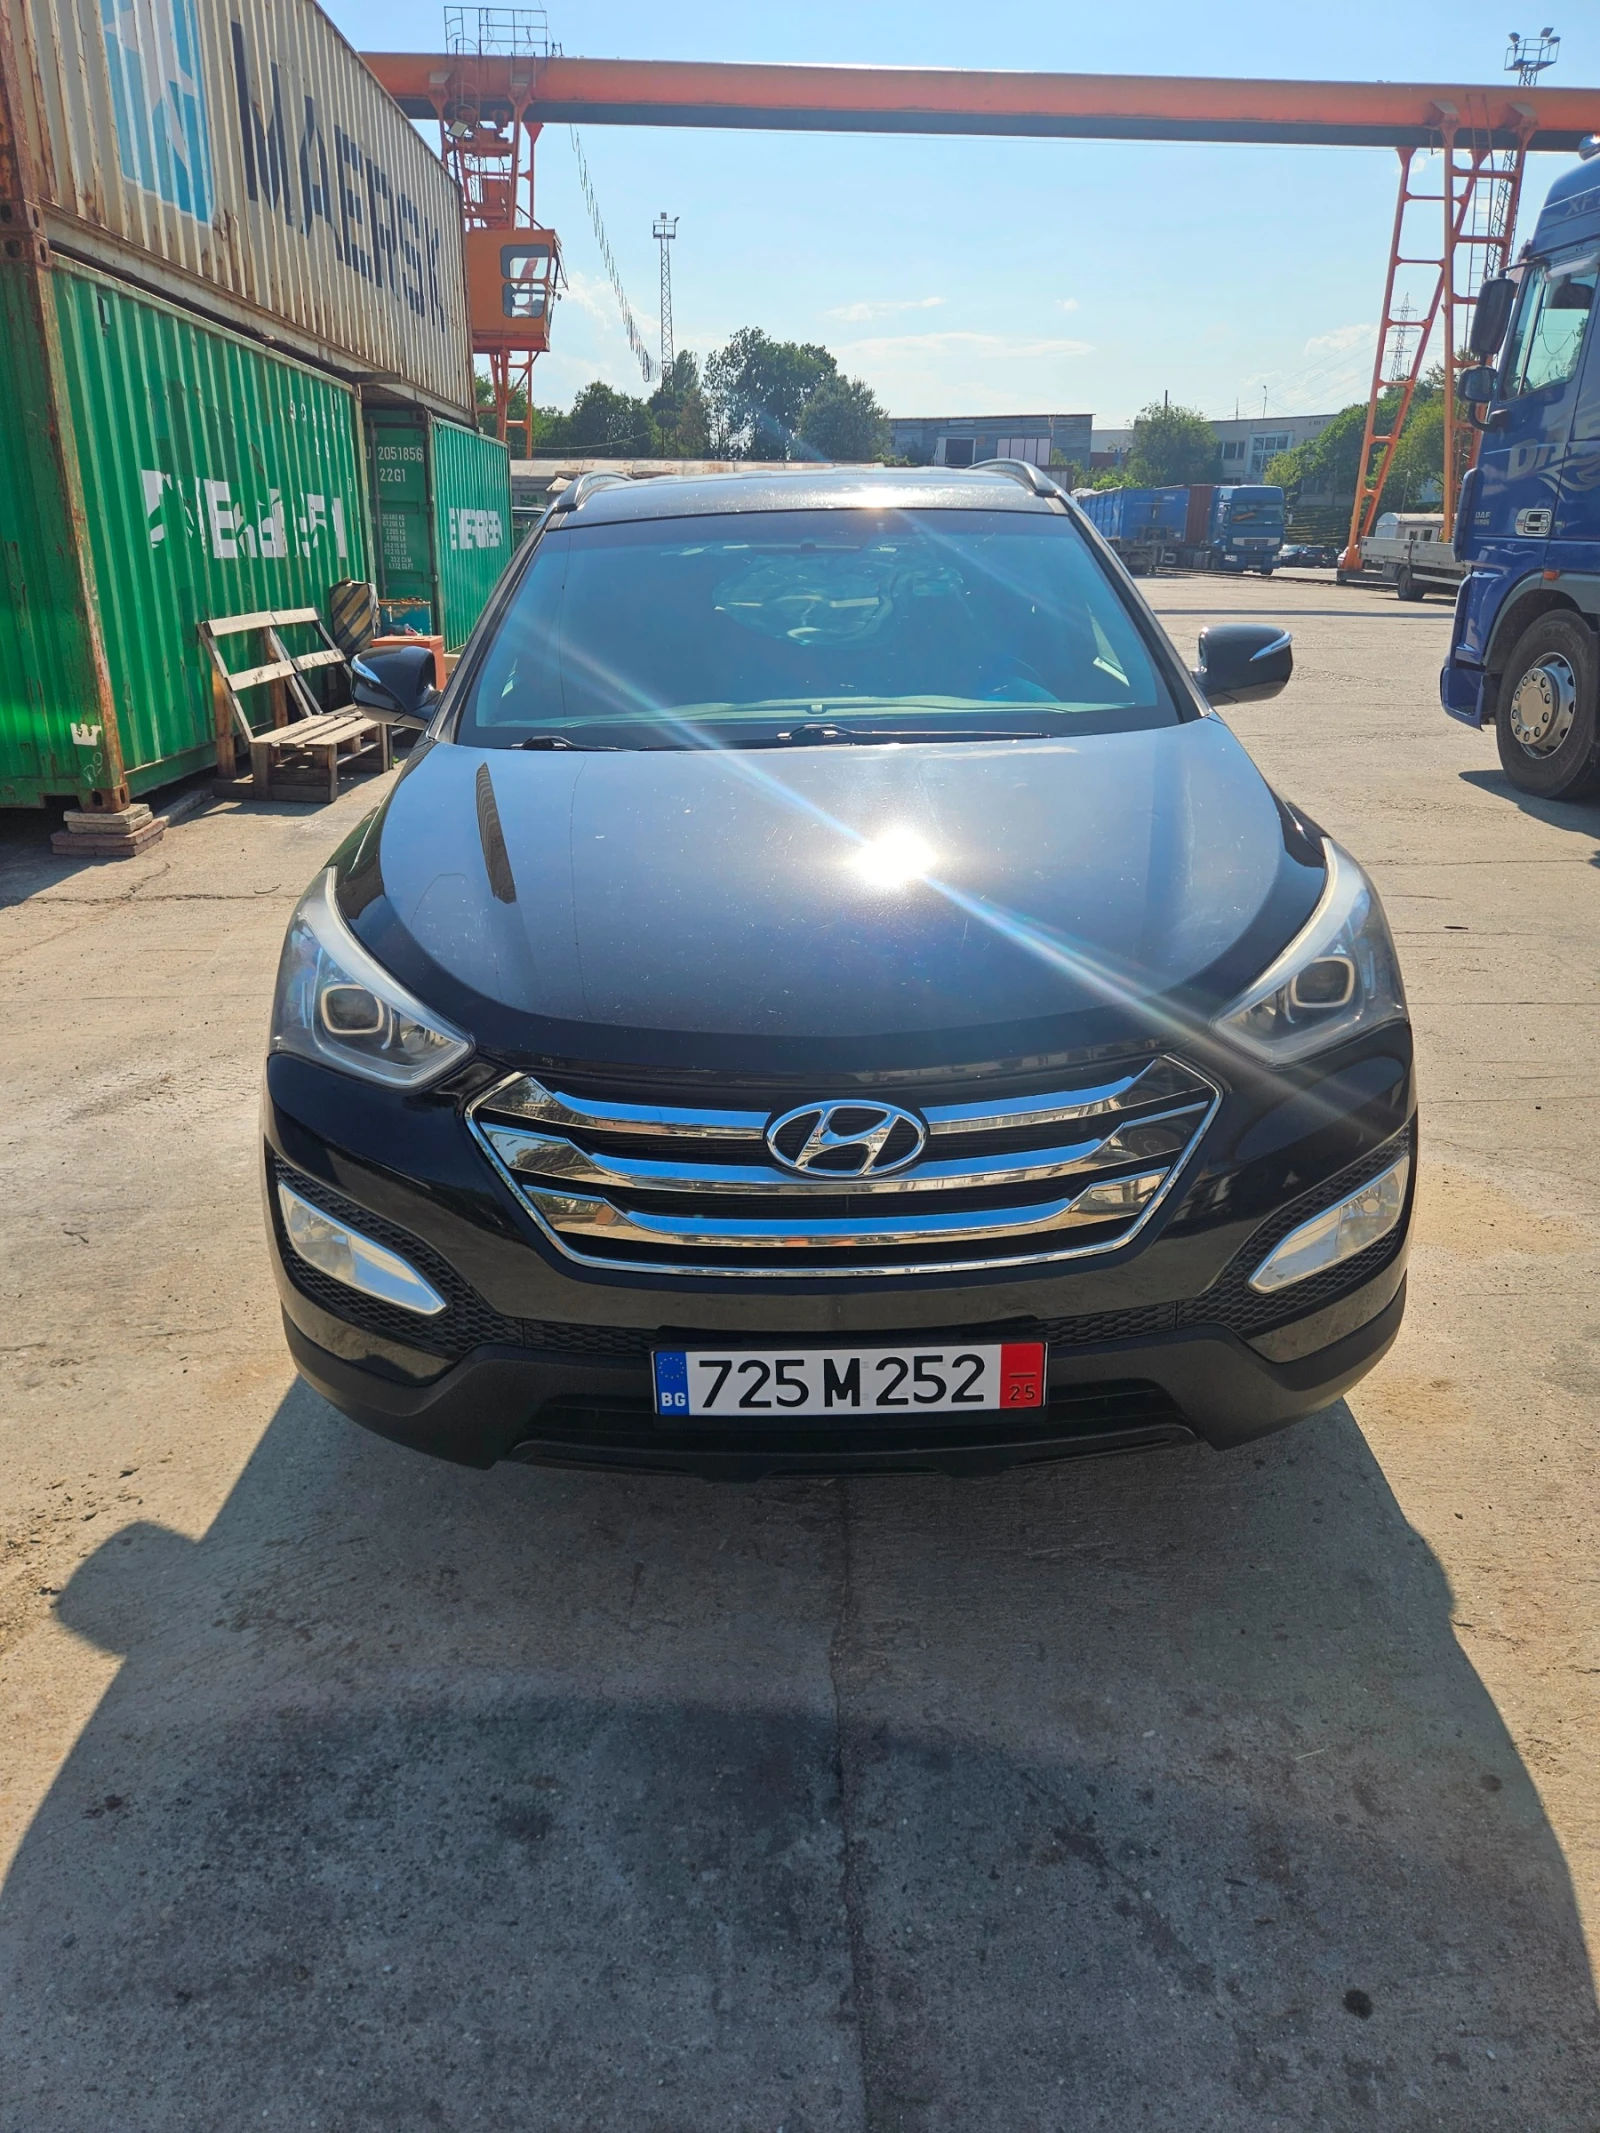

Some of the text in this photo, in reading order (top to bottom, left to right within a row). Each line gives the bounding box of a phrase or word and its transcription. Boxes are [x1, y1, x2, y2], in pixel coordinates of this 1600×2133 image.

[231, 21, 445, 332] MAERSK
[377, 446, 424, 462] 2051856
[379, 468, 406, 482] 22G1
[699, 1353, 986, 1409] 725 M 252
[661, 1392, 686, 1407] BG
[1009, 1384, 1036, 1401] 25
